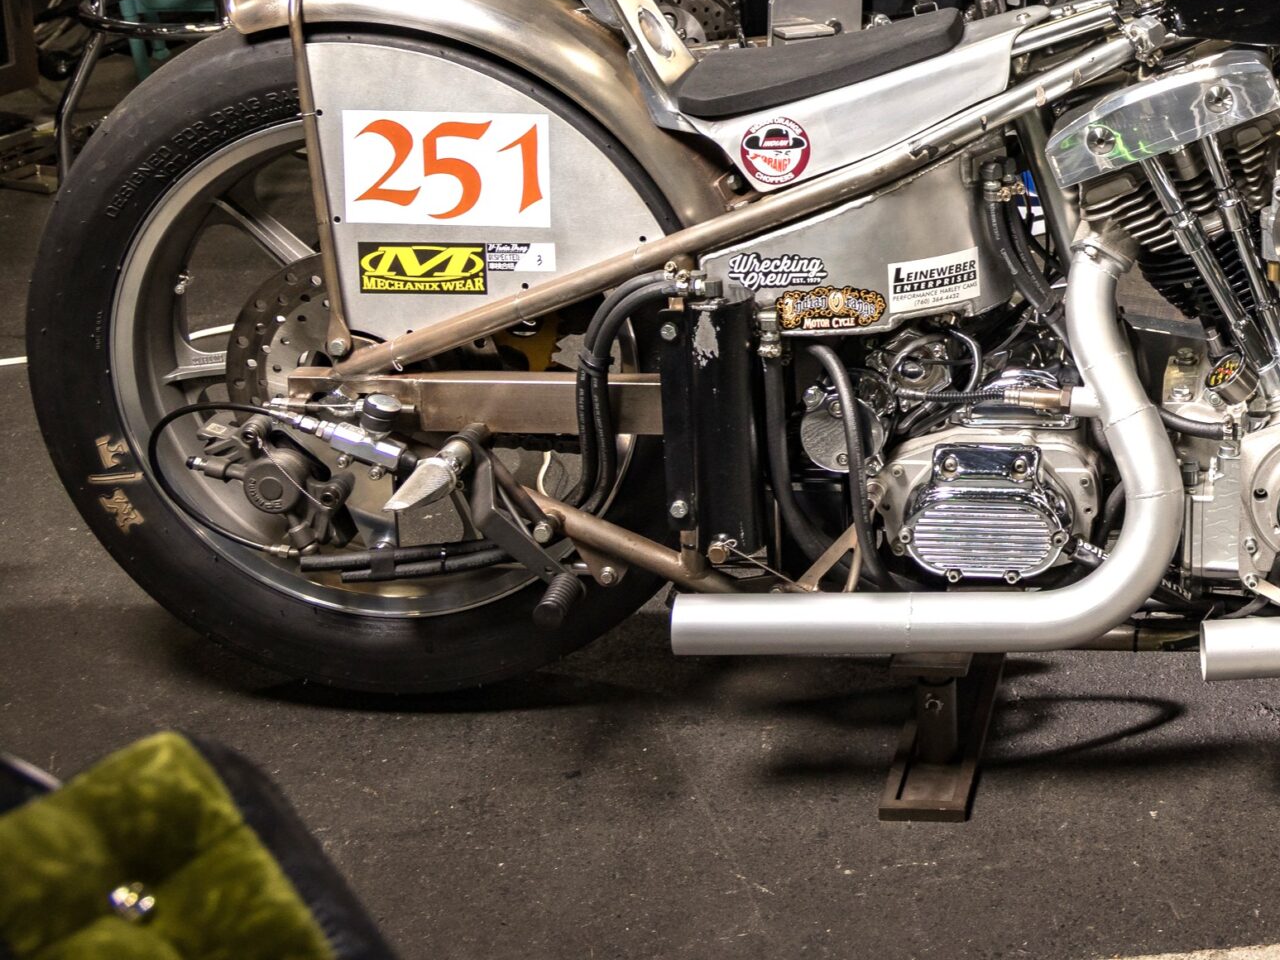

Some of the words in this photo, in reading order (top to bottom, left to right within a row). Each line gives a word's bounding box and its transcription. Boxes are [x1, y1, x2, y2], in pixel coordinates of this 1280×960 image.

[353, 118, 543, 220] 251
[728, 253, 824, 277] Wrecking
[362, 275, 440, 291] MECHANIX
[441, 278, 485, 291] WEAR
[739, 272, 793, 291] Crew
[892, 289, 938, 302] PERFORMANCE
[939, 284, 961, 294] HARLEY
[962, 281, 978, 290] CAMS
[895, 271, 975, 293] ENTERPRISES
